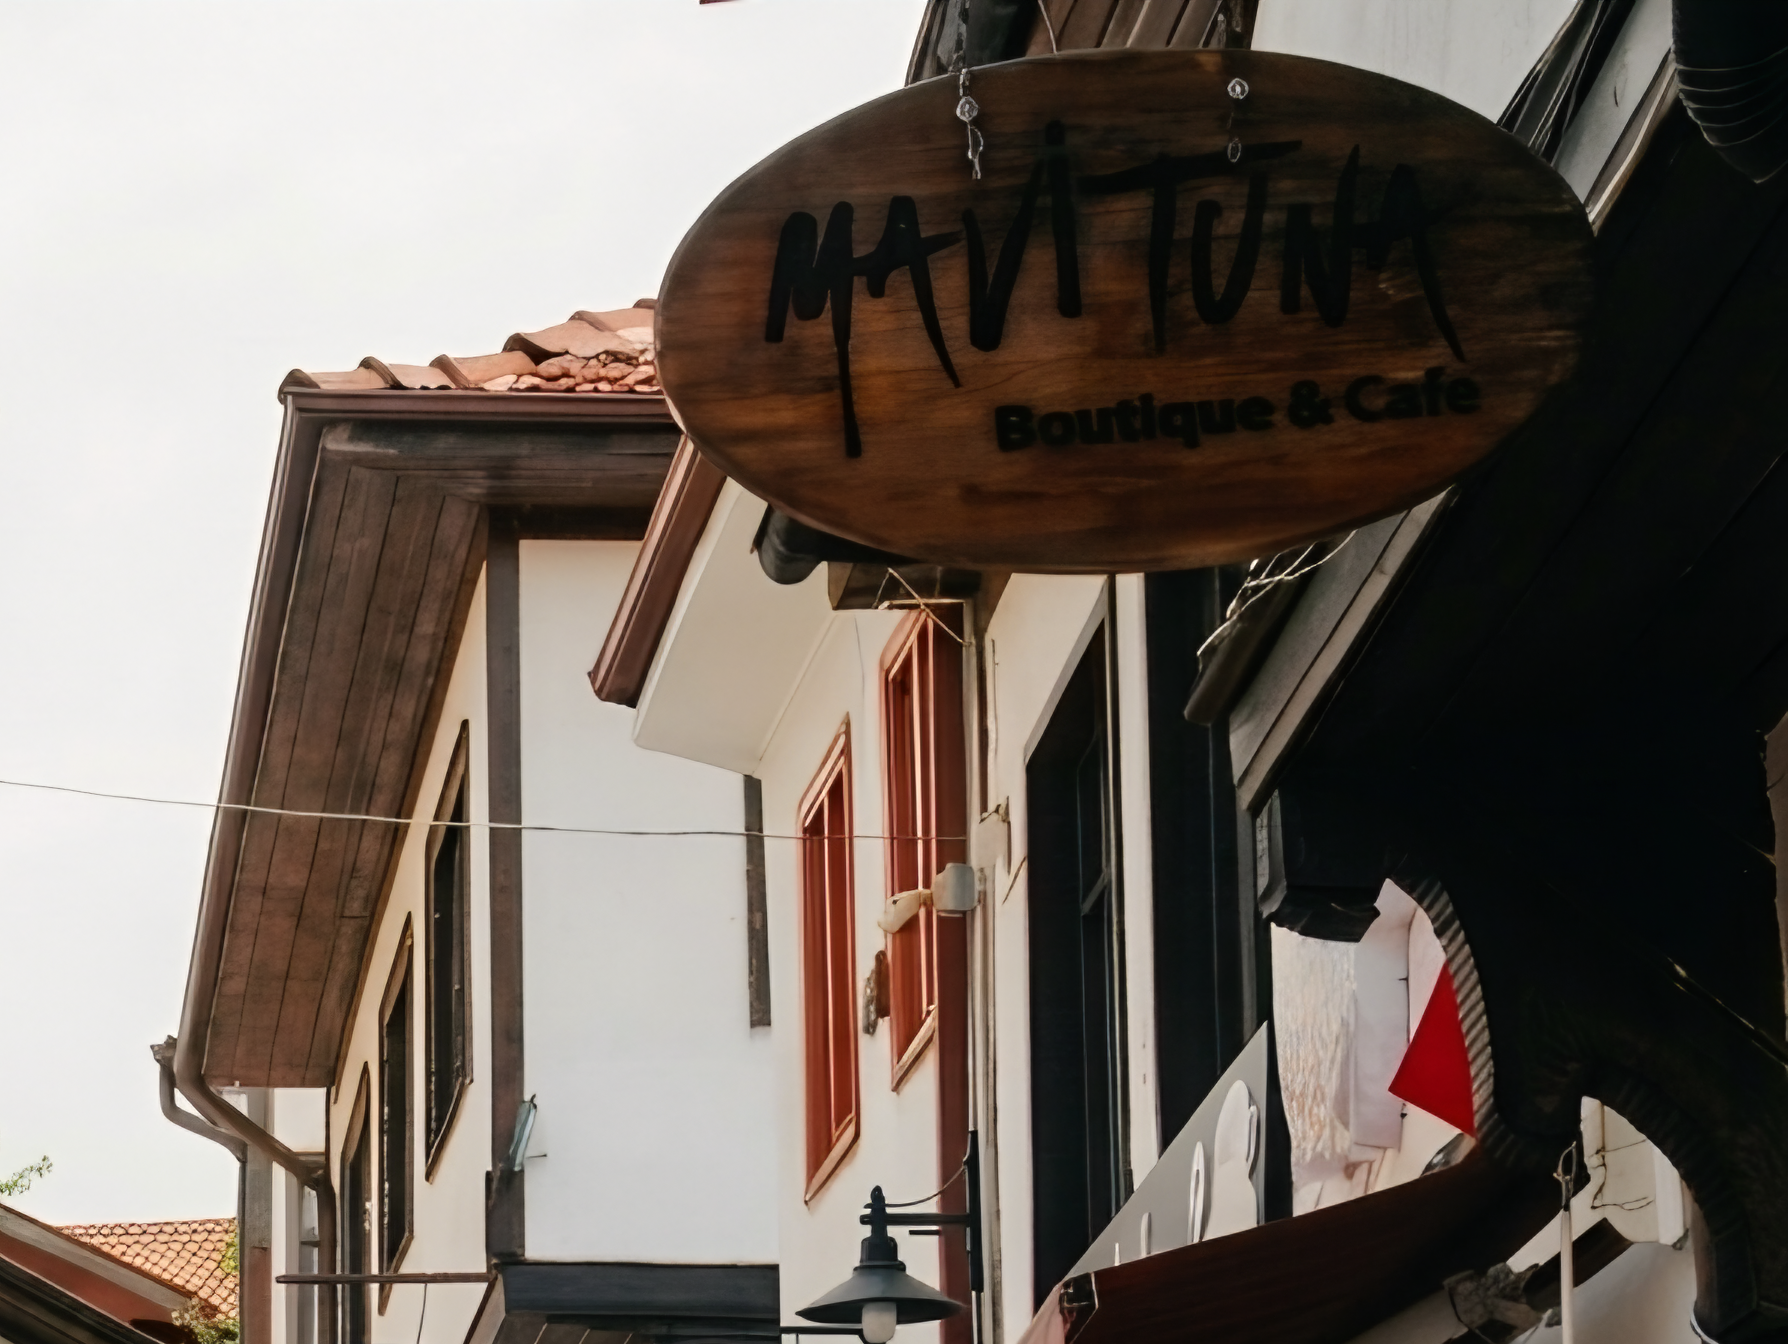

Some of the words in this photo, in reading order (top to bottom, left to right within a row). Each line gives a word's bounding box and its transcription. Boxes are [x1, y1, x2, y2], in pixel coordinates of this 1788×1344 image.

[1078, 140, 1466, 363] TUNA
[995, 393, 1275, 451] Boutique
[1288, 380, 1334, 428] &
[1344, 366, 1481, 423] Cafe
